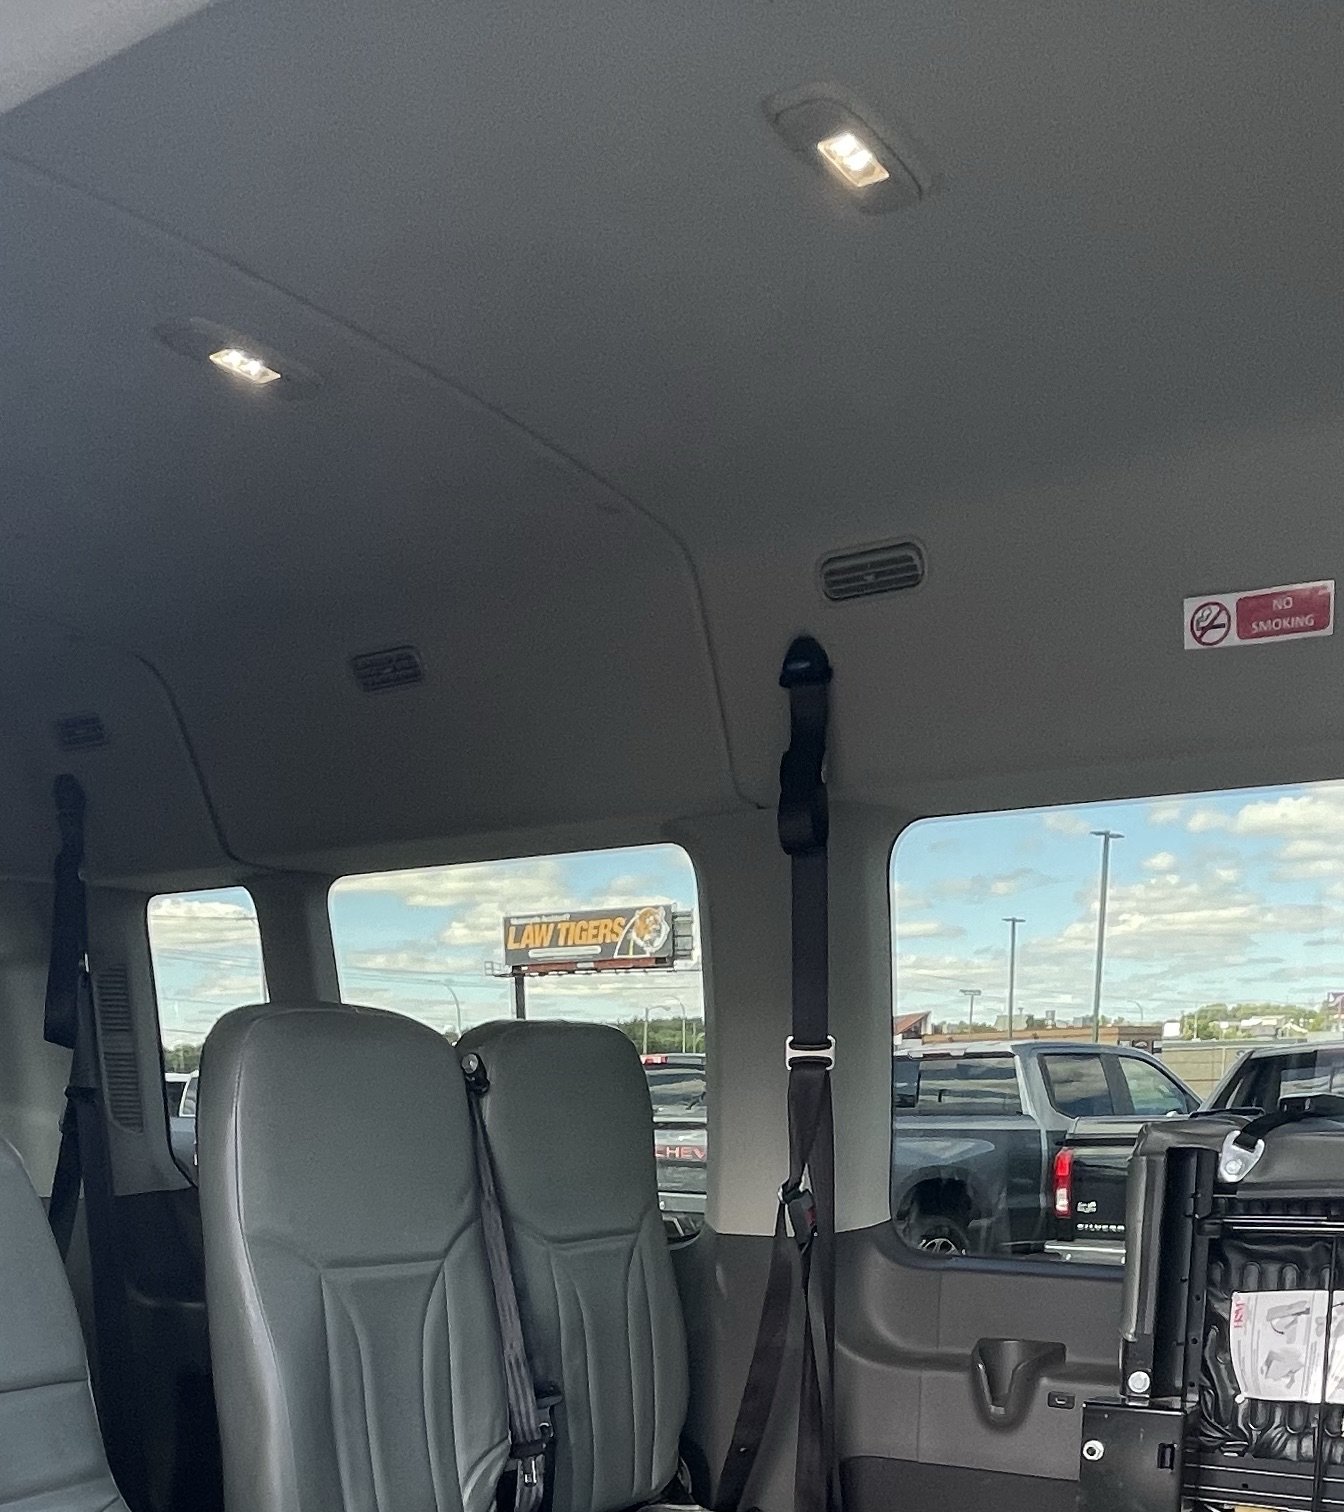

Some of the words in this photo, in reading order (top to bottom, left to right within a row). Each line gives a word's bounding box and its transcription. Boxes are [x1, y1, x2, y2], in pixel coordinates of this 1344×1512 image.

[1272, 596, 1293, 610] NO
[1251, 613, 1315, 634] SMOKING
[507, 922, 555, 950] LAW
[557, 916, 626, 947] TIGERS
